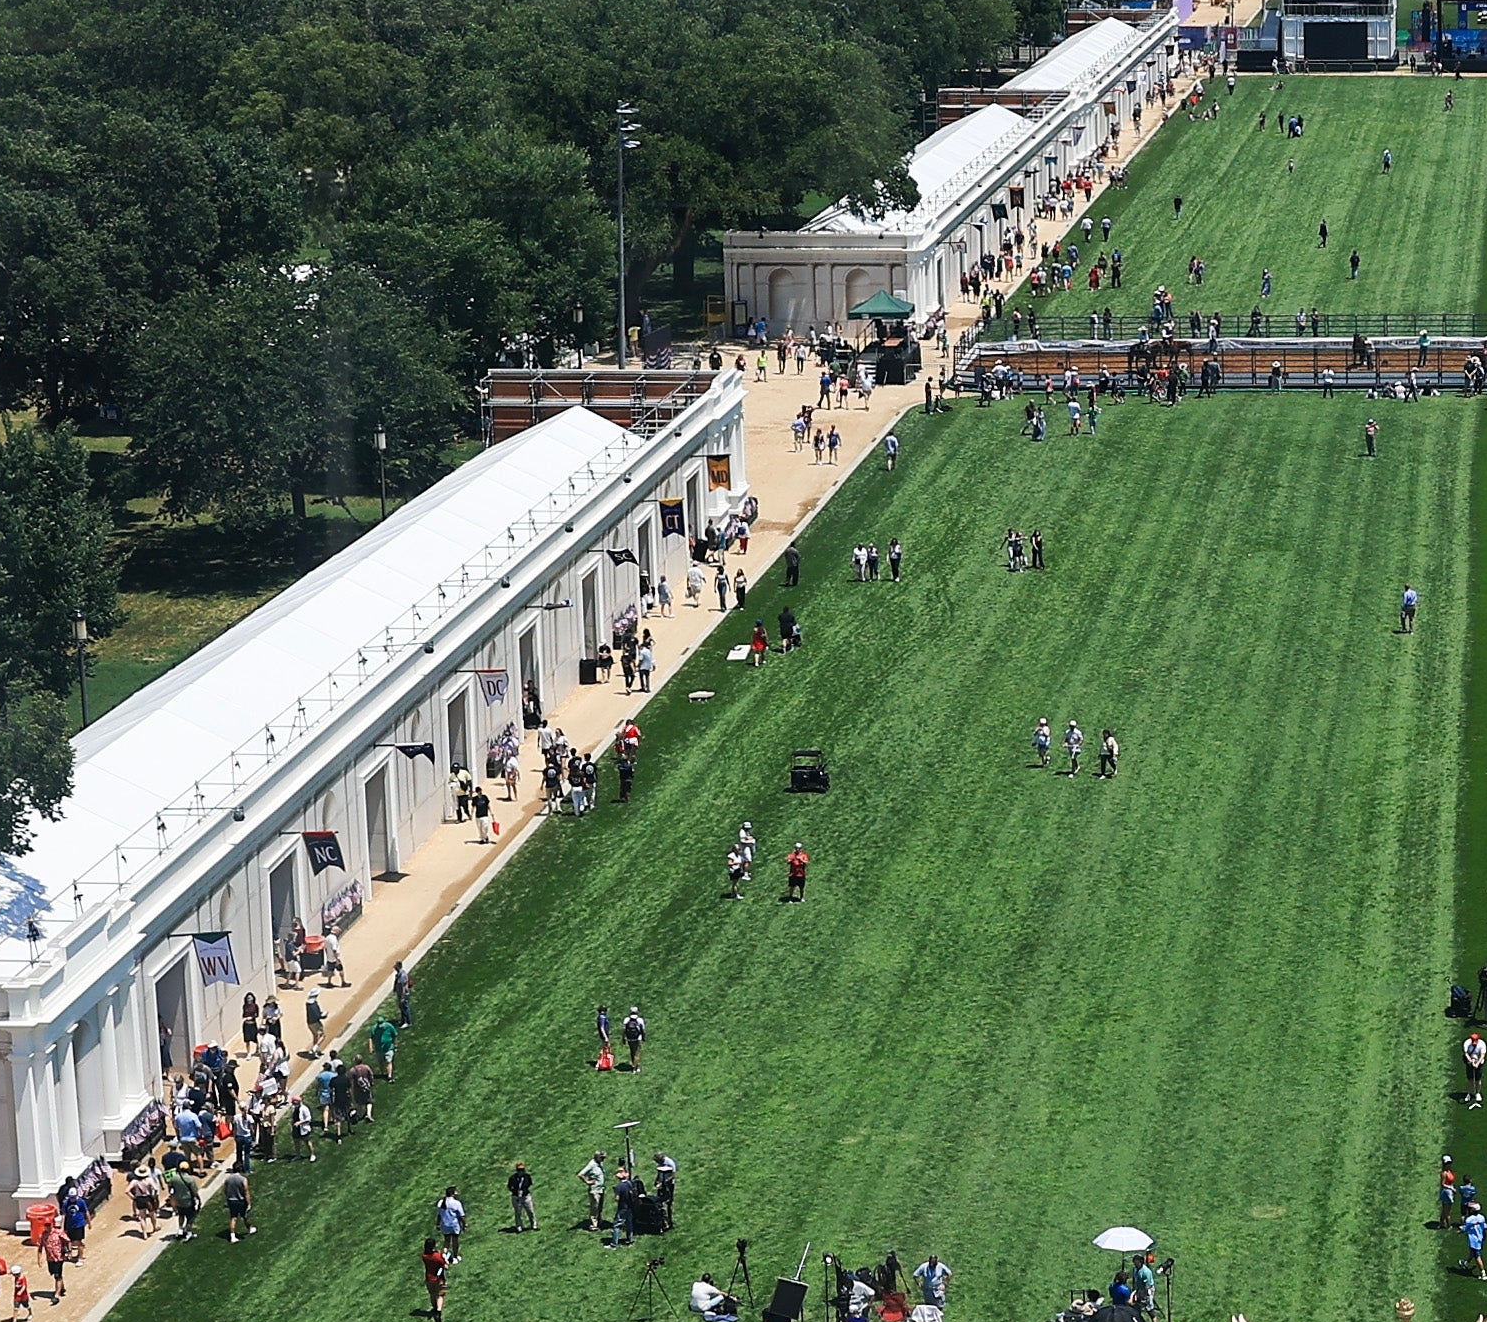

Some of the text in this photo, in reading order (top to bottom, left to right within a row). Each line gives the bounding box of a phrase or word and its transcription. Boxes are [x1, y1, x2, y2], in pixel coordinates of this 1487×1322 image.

[712, 470, 728, 485] MD
[666, 514, 680, 530] CT
[615, 551, 633, 562] SC
[487, 681, 503, 696] DC
[315, 846, 337, 864] NC
[201, 955, 229, 976] WV
